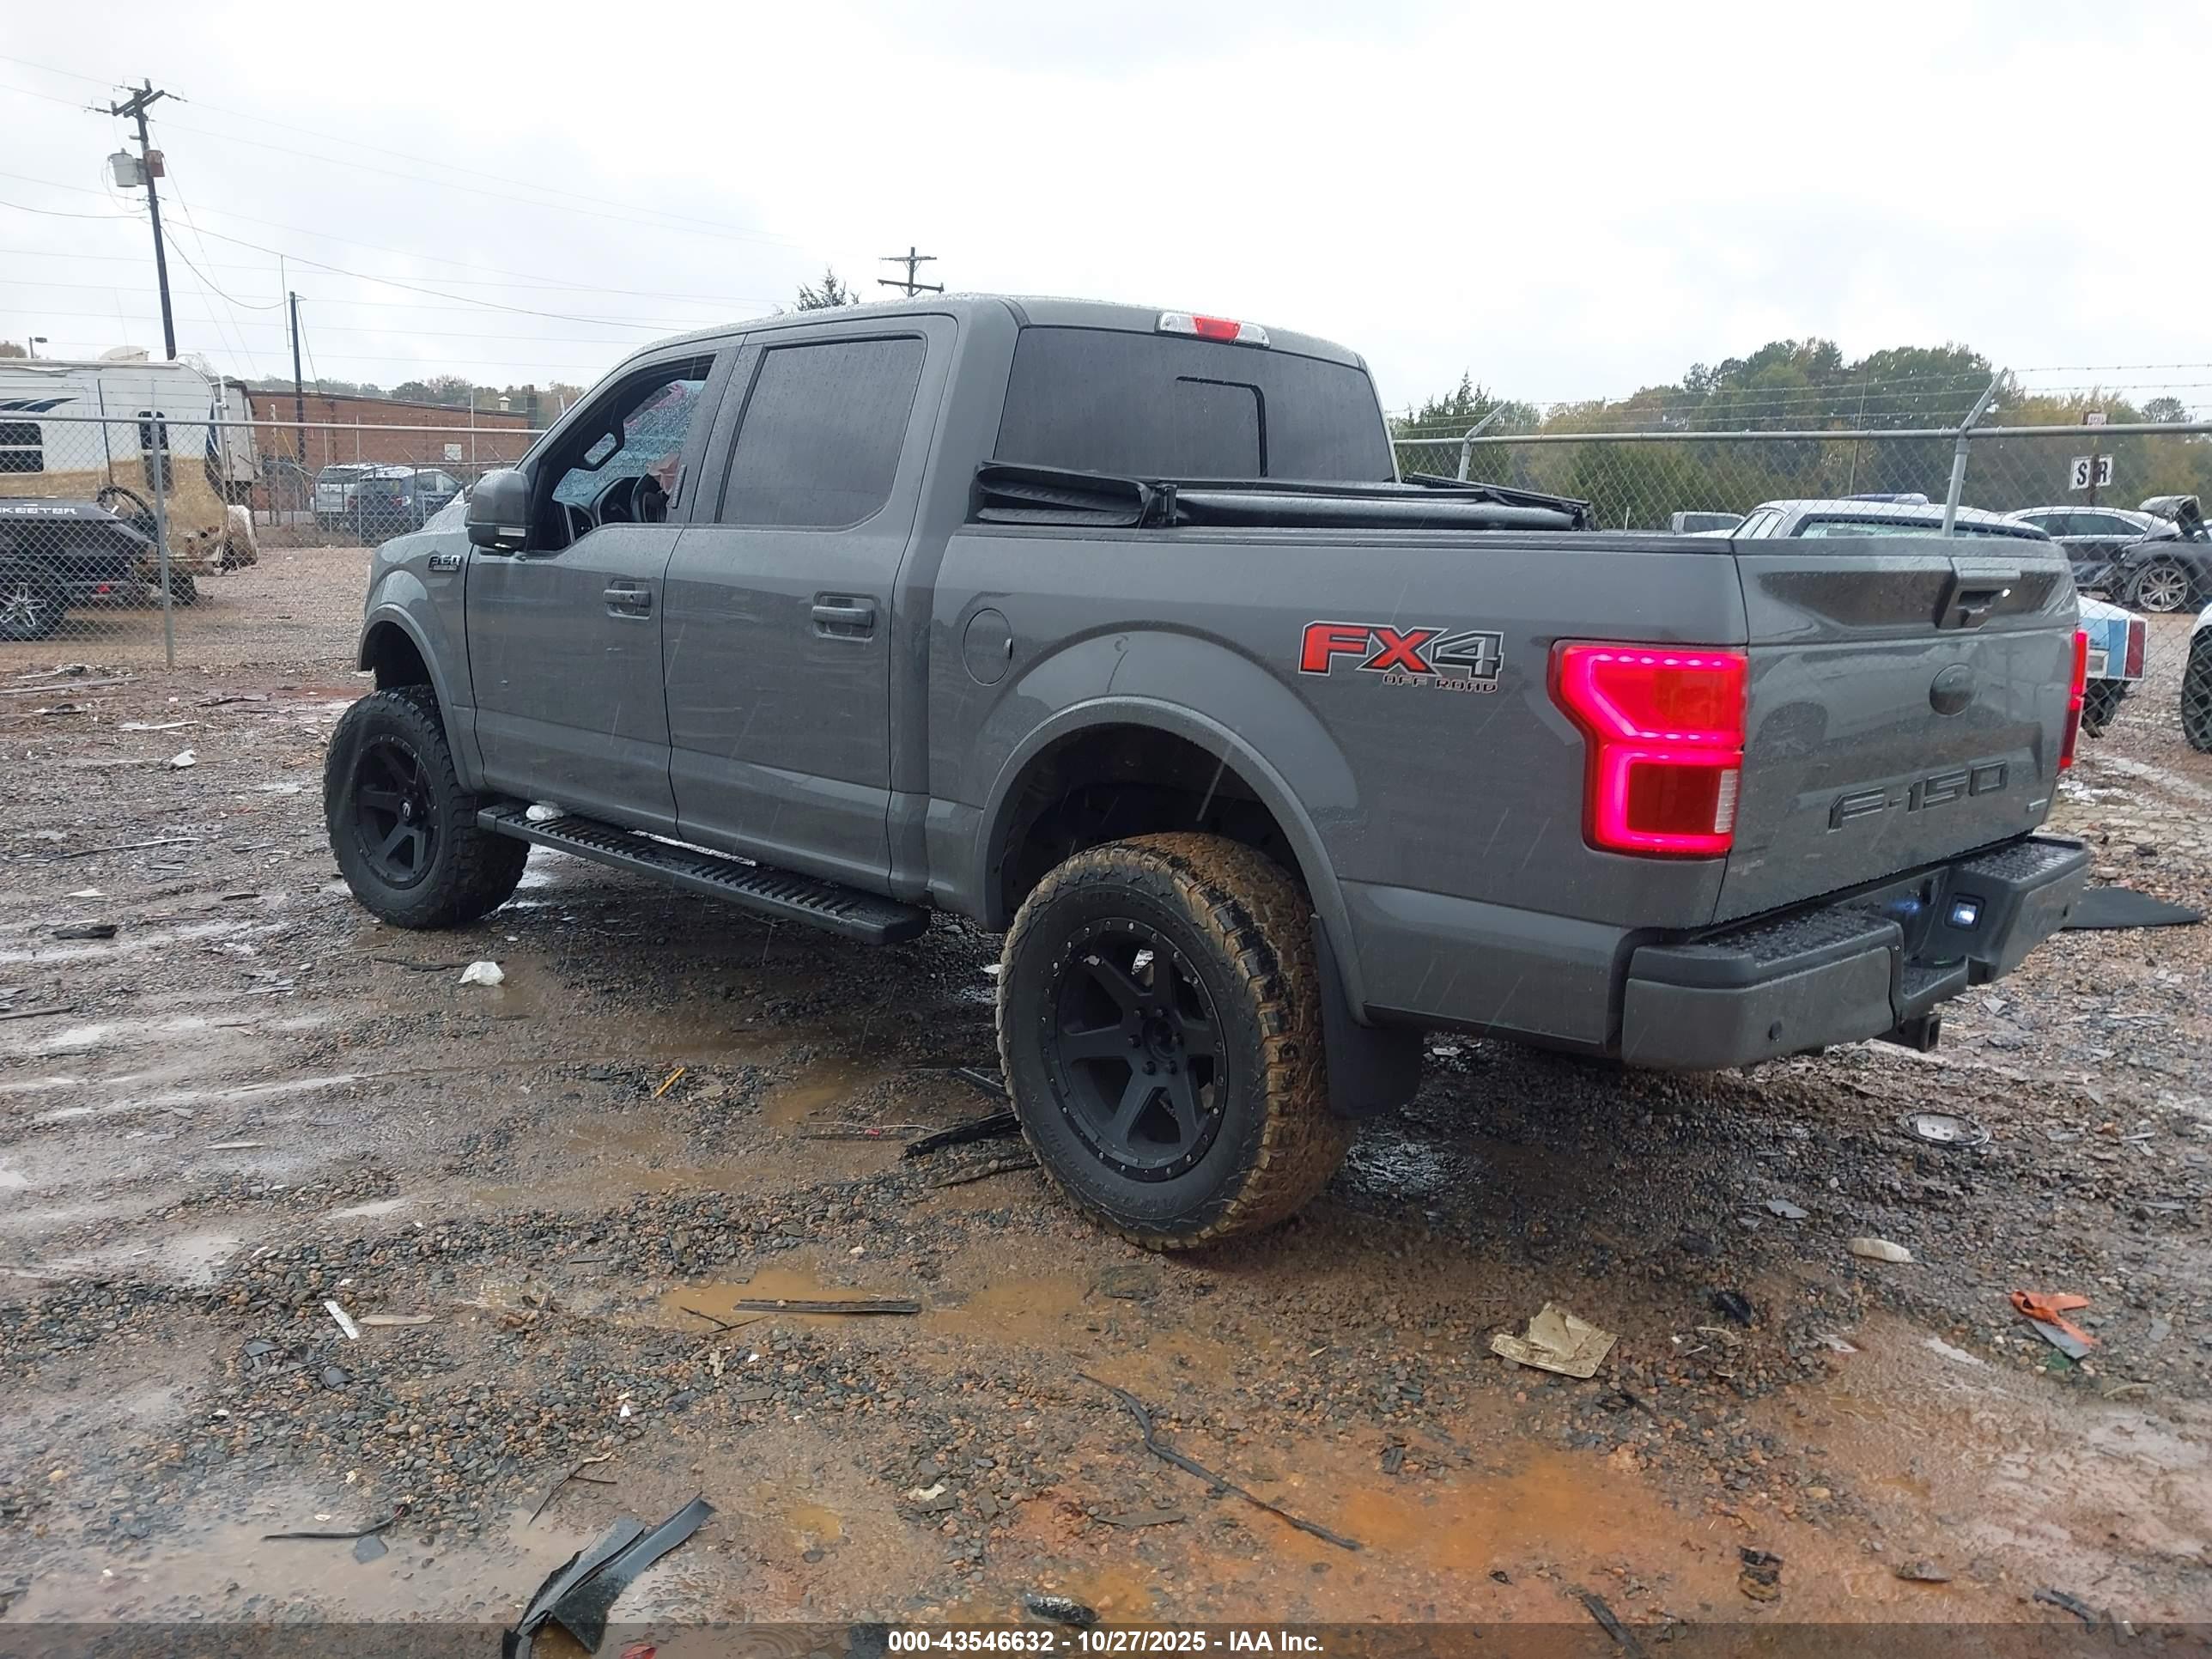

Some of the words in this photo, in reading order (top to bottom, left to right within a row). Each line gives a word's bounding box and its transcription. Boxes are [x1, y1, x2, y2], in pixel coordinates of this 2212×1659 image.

[1298, 620, 1504, 681] FX4
[1382, 673, 1428, 687] OFF
[1434, 678, 1498, 694] ROAD
